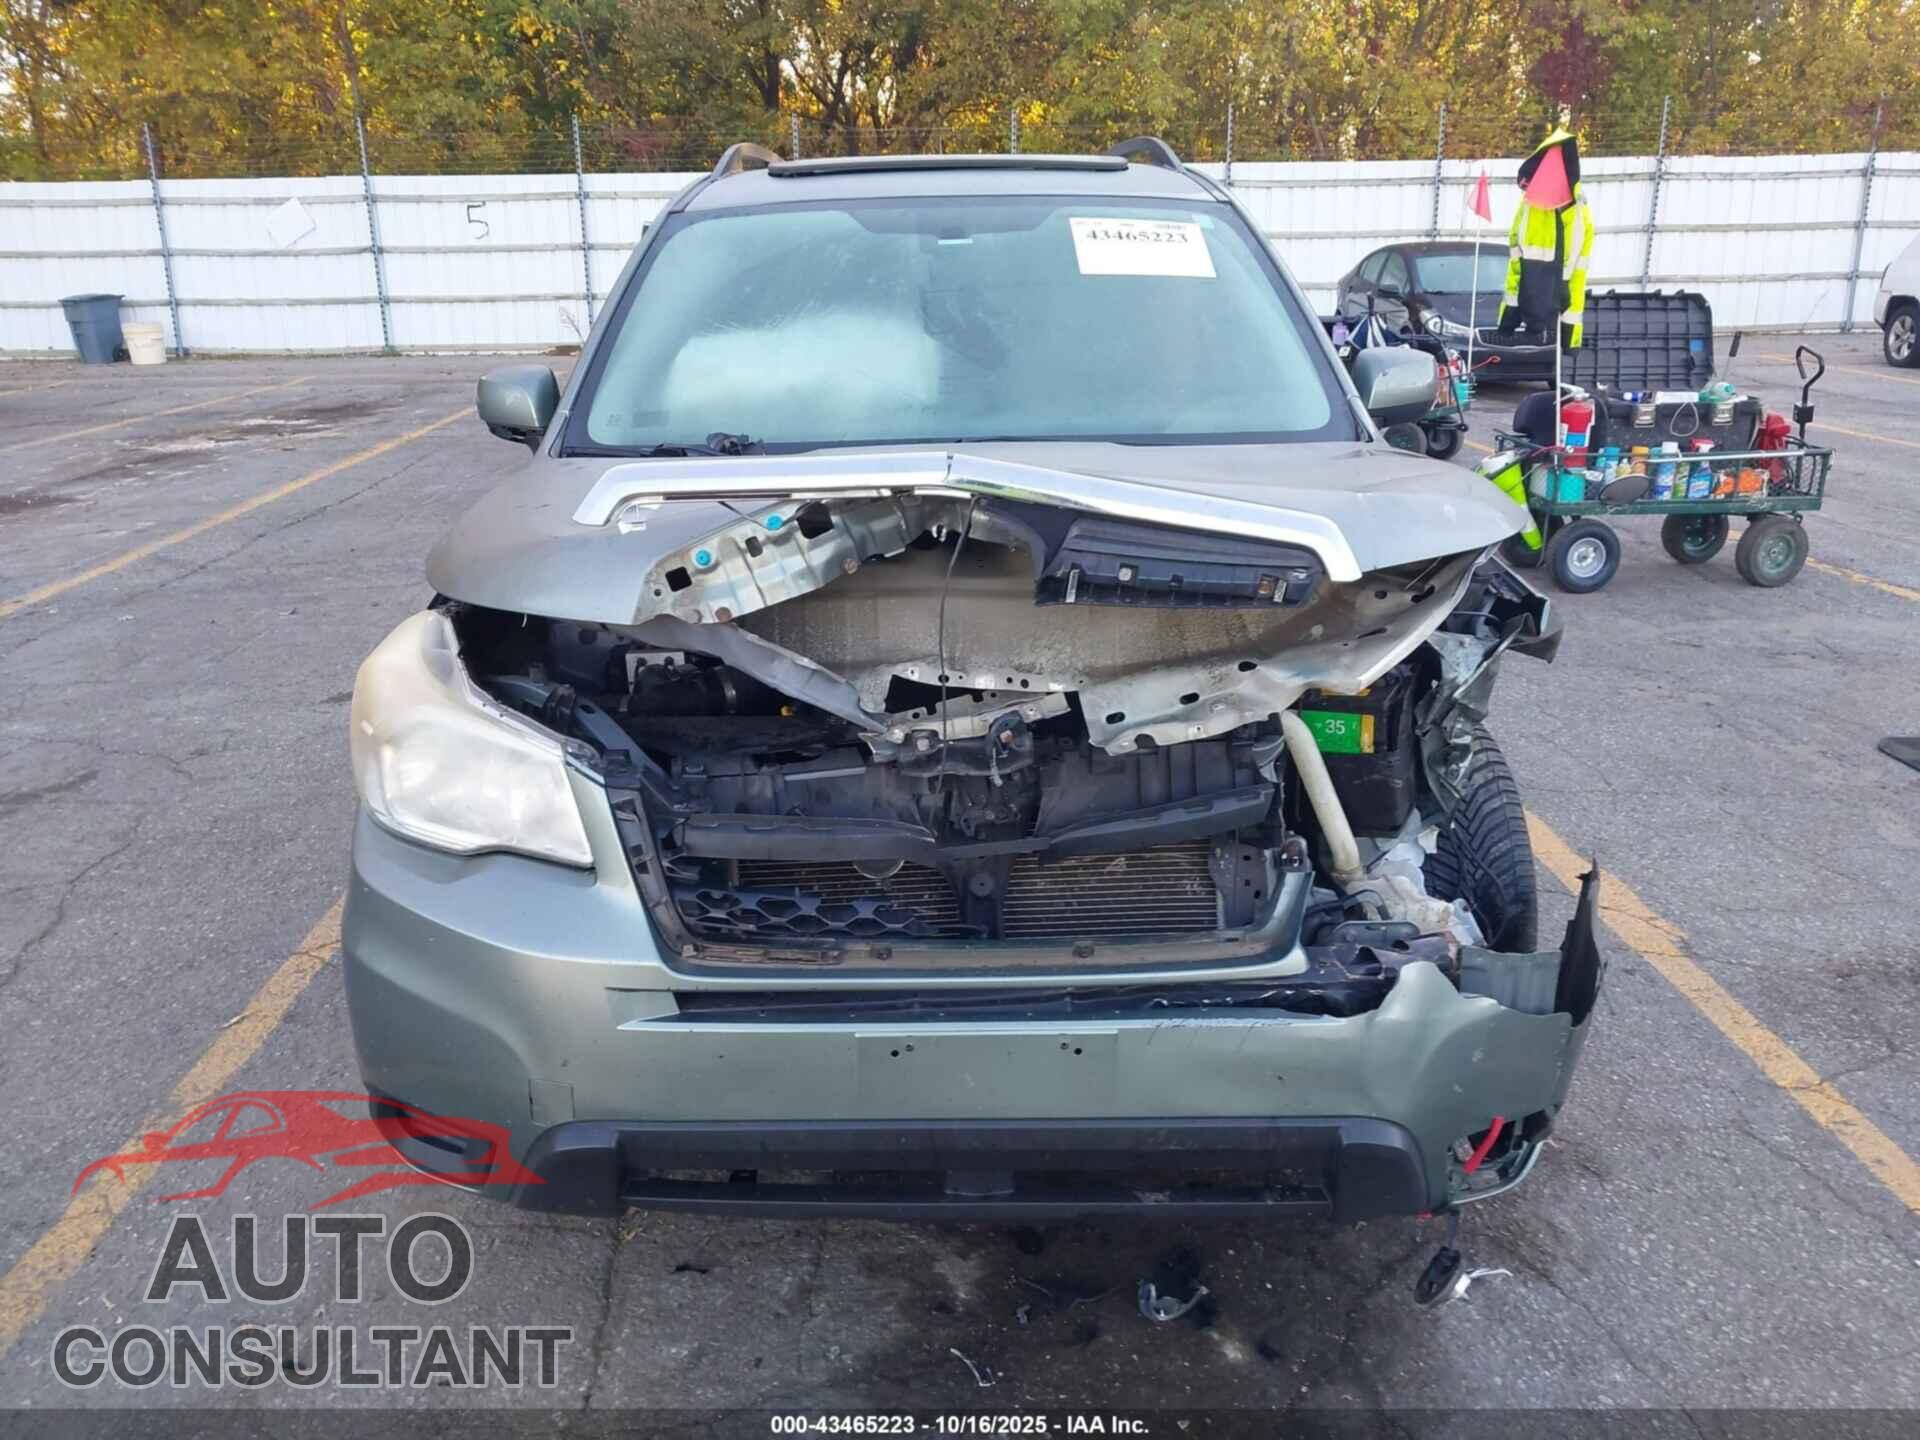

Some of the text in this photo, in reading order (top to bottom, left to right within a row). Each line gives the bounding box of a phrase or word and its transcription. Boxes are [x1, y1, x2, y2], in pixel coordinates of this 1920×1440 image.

[465, 201, 490, 240] 5
[1086, 229, 1188, 243] 43465223
[1324, 719, 1345, 734] 35
